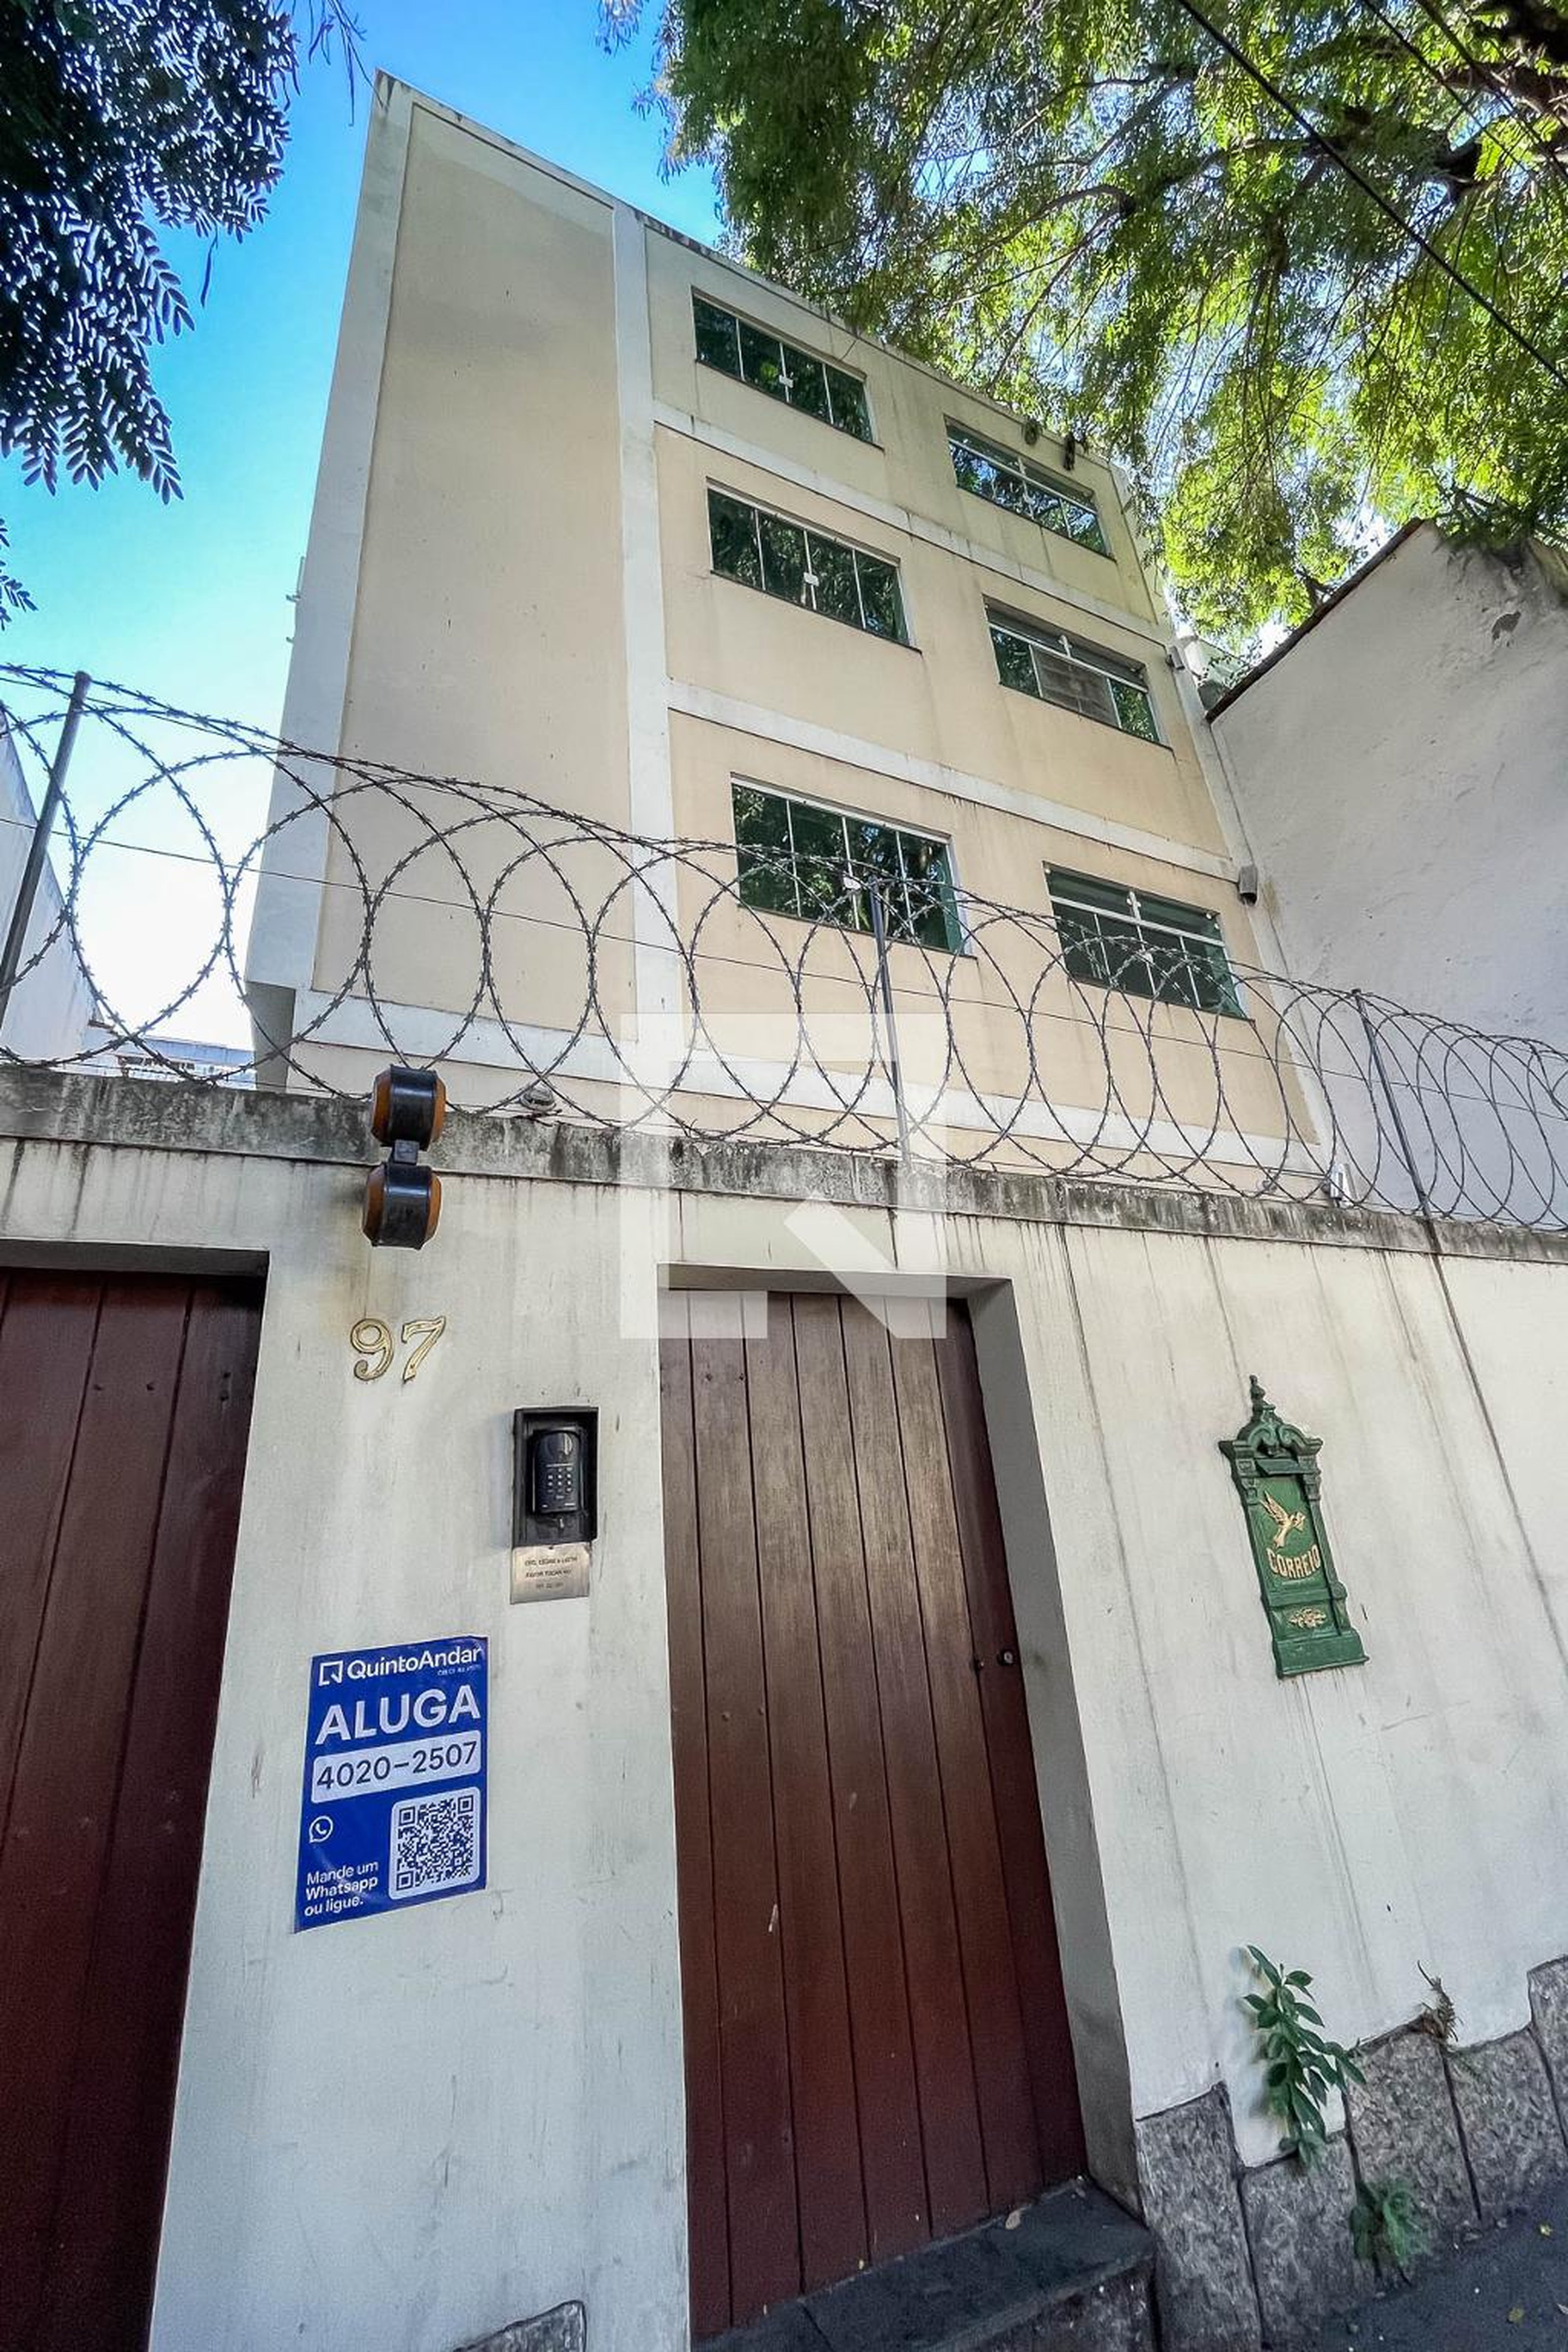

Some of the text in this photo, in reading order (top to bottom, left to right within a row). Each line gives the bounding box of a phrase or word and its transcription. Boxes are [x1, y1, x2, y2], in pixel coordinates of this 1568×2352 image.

[350, 1316, 446, 1383] 97
[1266, 1544, 1321, 1579] CORREIO
[347, 1646, 481, 1679] QuintoAndar
[315, 1684, 481, 1745] ALUGA
[317, 1741, 477, 1789] 4020-2507
[306, 1877, 378, 1900] Whatsapp
[307, 1862, 379, 1885] Mande um
[305, 1896, 363, 1916] ou ligue.
